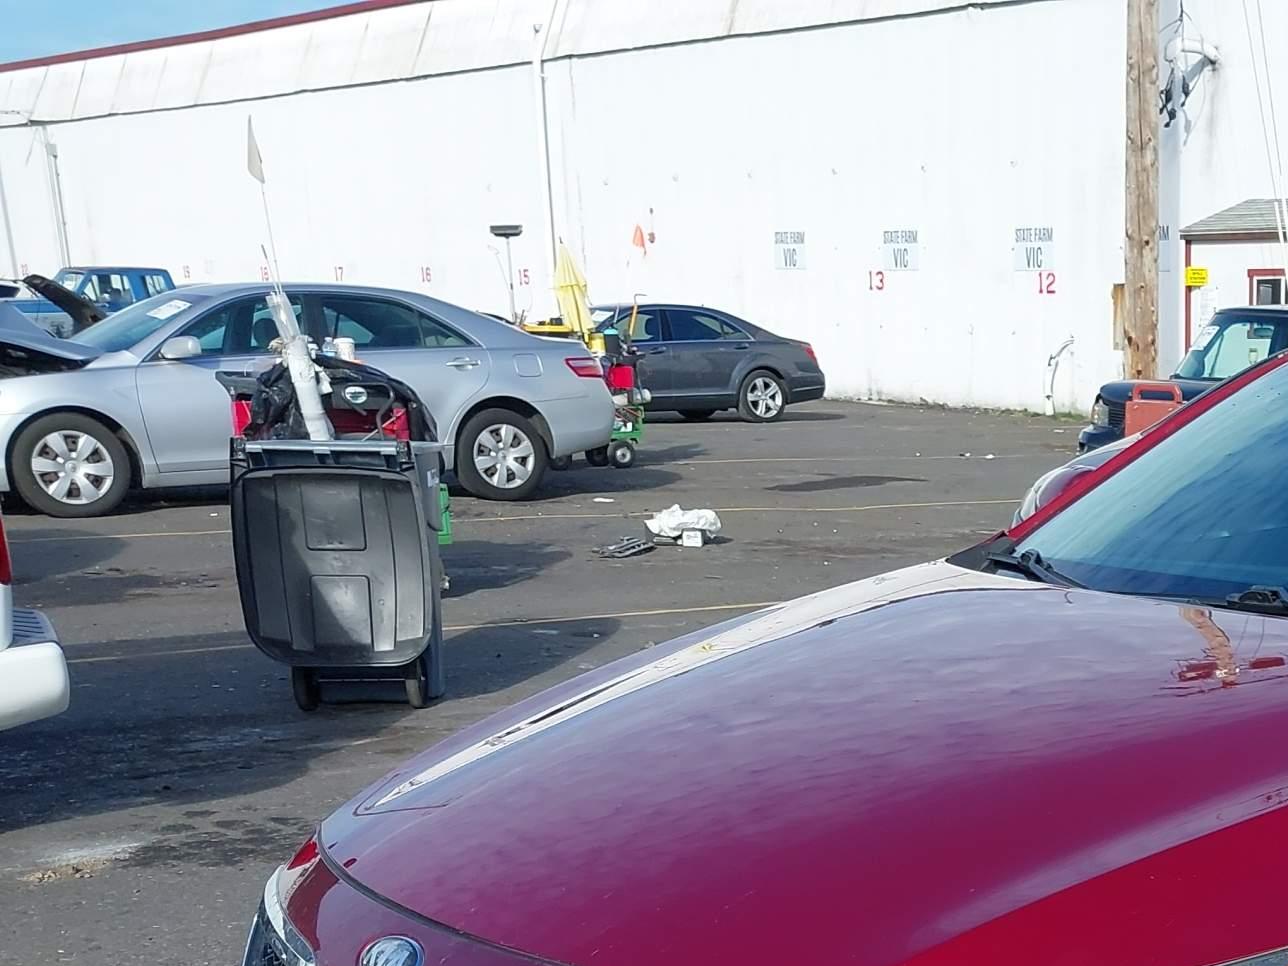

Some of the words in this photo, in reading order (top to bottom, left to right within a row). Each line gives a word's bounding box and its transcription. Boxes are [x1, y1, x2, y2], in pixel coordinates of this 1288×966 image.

[775, 231, 789, 244] STATE
[790, 231, 805, 244] FARM
[883, 230, 900, 244] STATE
[901, 230, 918, 244] FARM
[1015, 228, 1033, 243] STATE
[1034, 227, 1053, 242] FARM
[783, 247, 797, 267] VIC
[893, 247, 909, 269] VIC
[1025, 246, 1043, 269] VIC
[334, 265, 344, 281] 17
[421, 266, 432, 282] 16
[518, 268, 530, 286] 15
[868, 270, 885, 290] 13
[1038, 271, 1056, 294] 12
